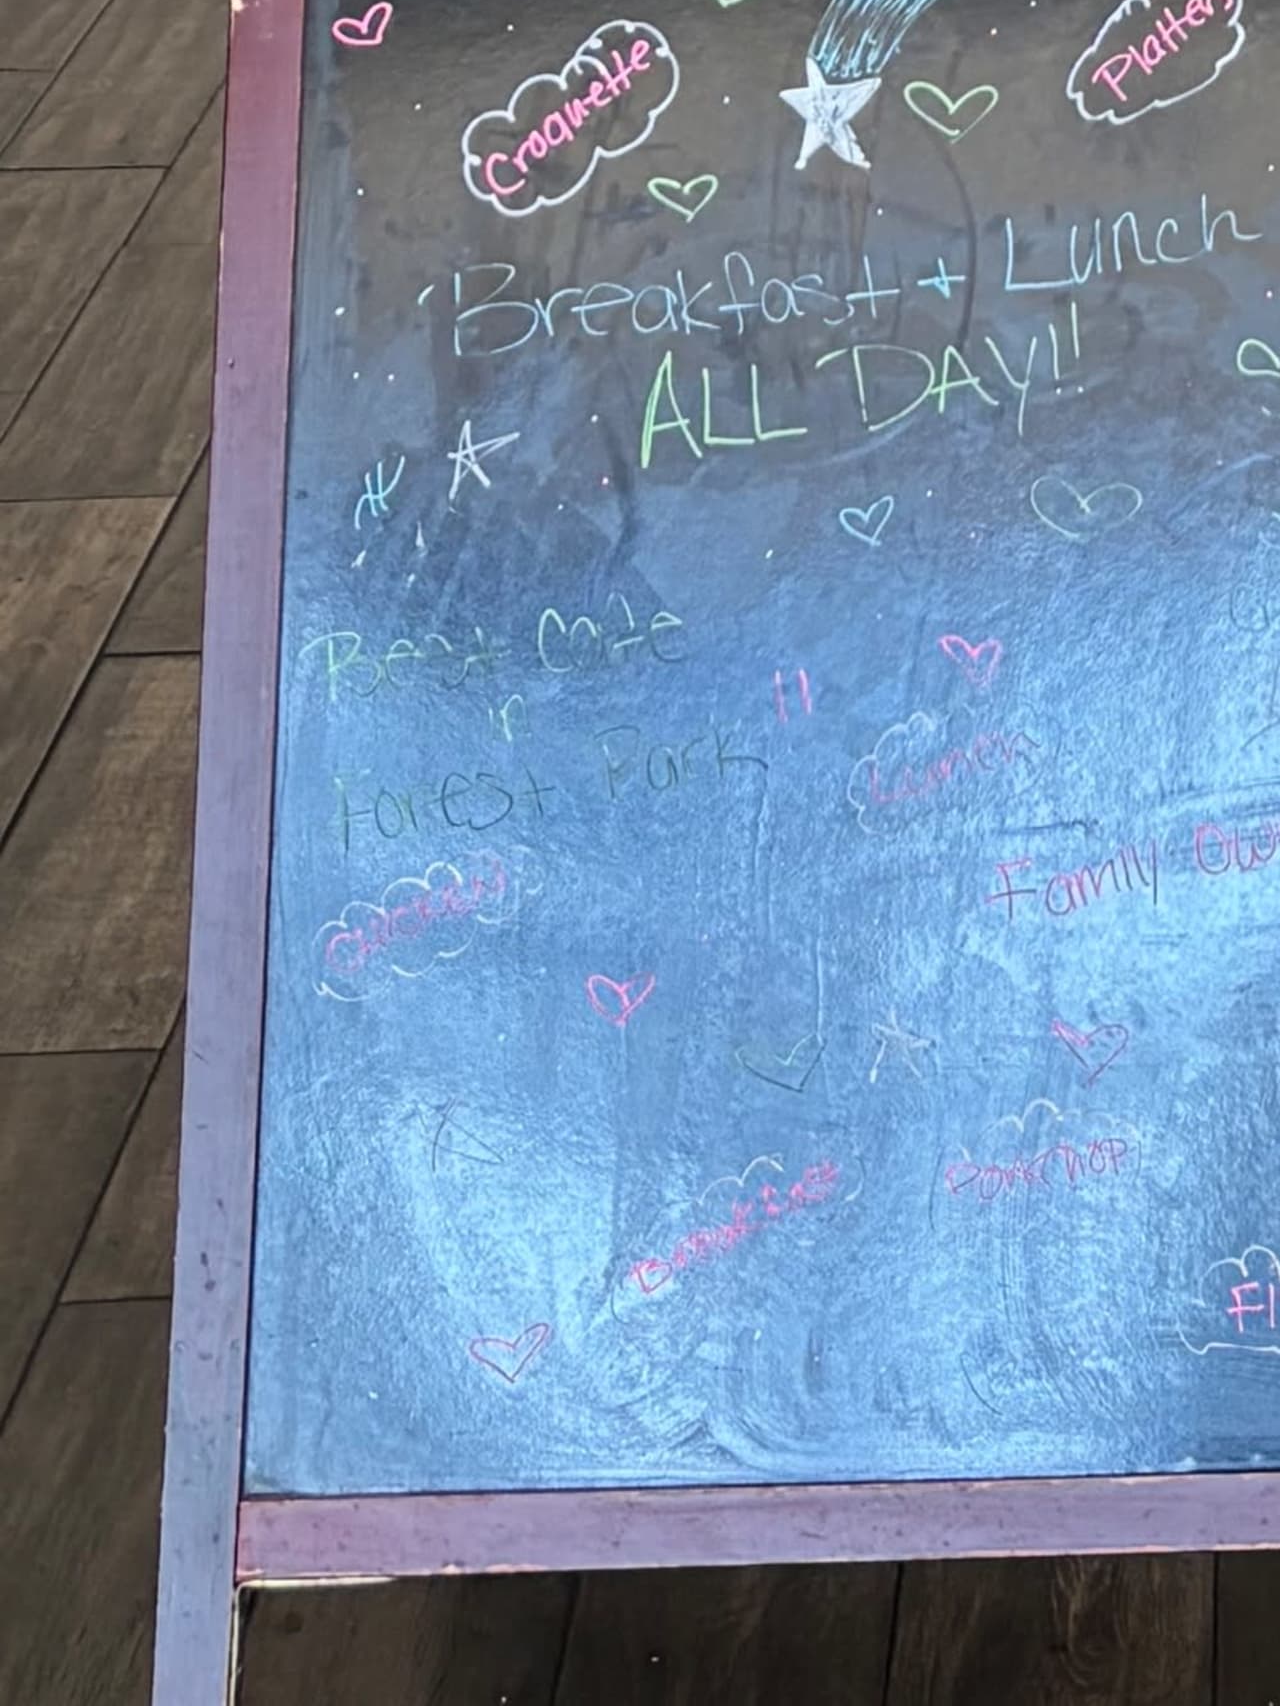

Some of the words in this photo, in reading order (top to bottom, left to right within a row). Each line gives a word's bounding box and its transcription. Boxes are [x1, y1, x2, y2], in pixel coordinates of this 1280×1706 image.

[448, 251, 902, 357] Breakfast
[1004, 193, 1264, 291] Lunch
[638, 349, 808, 469] ALL
